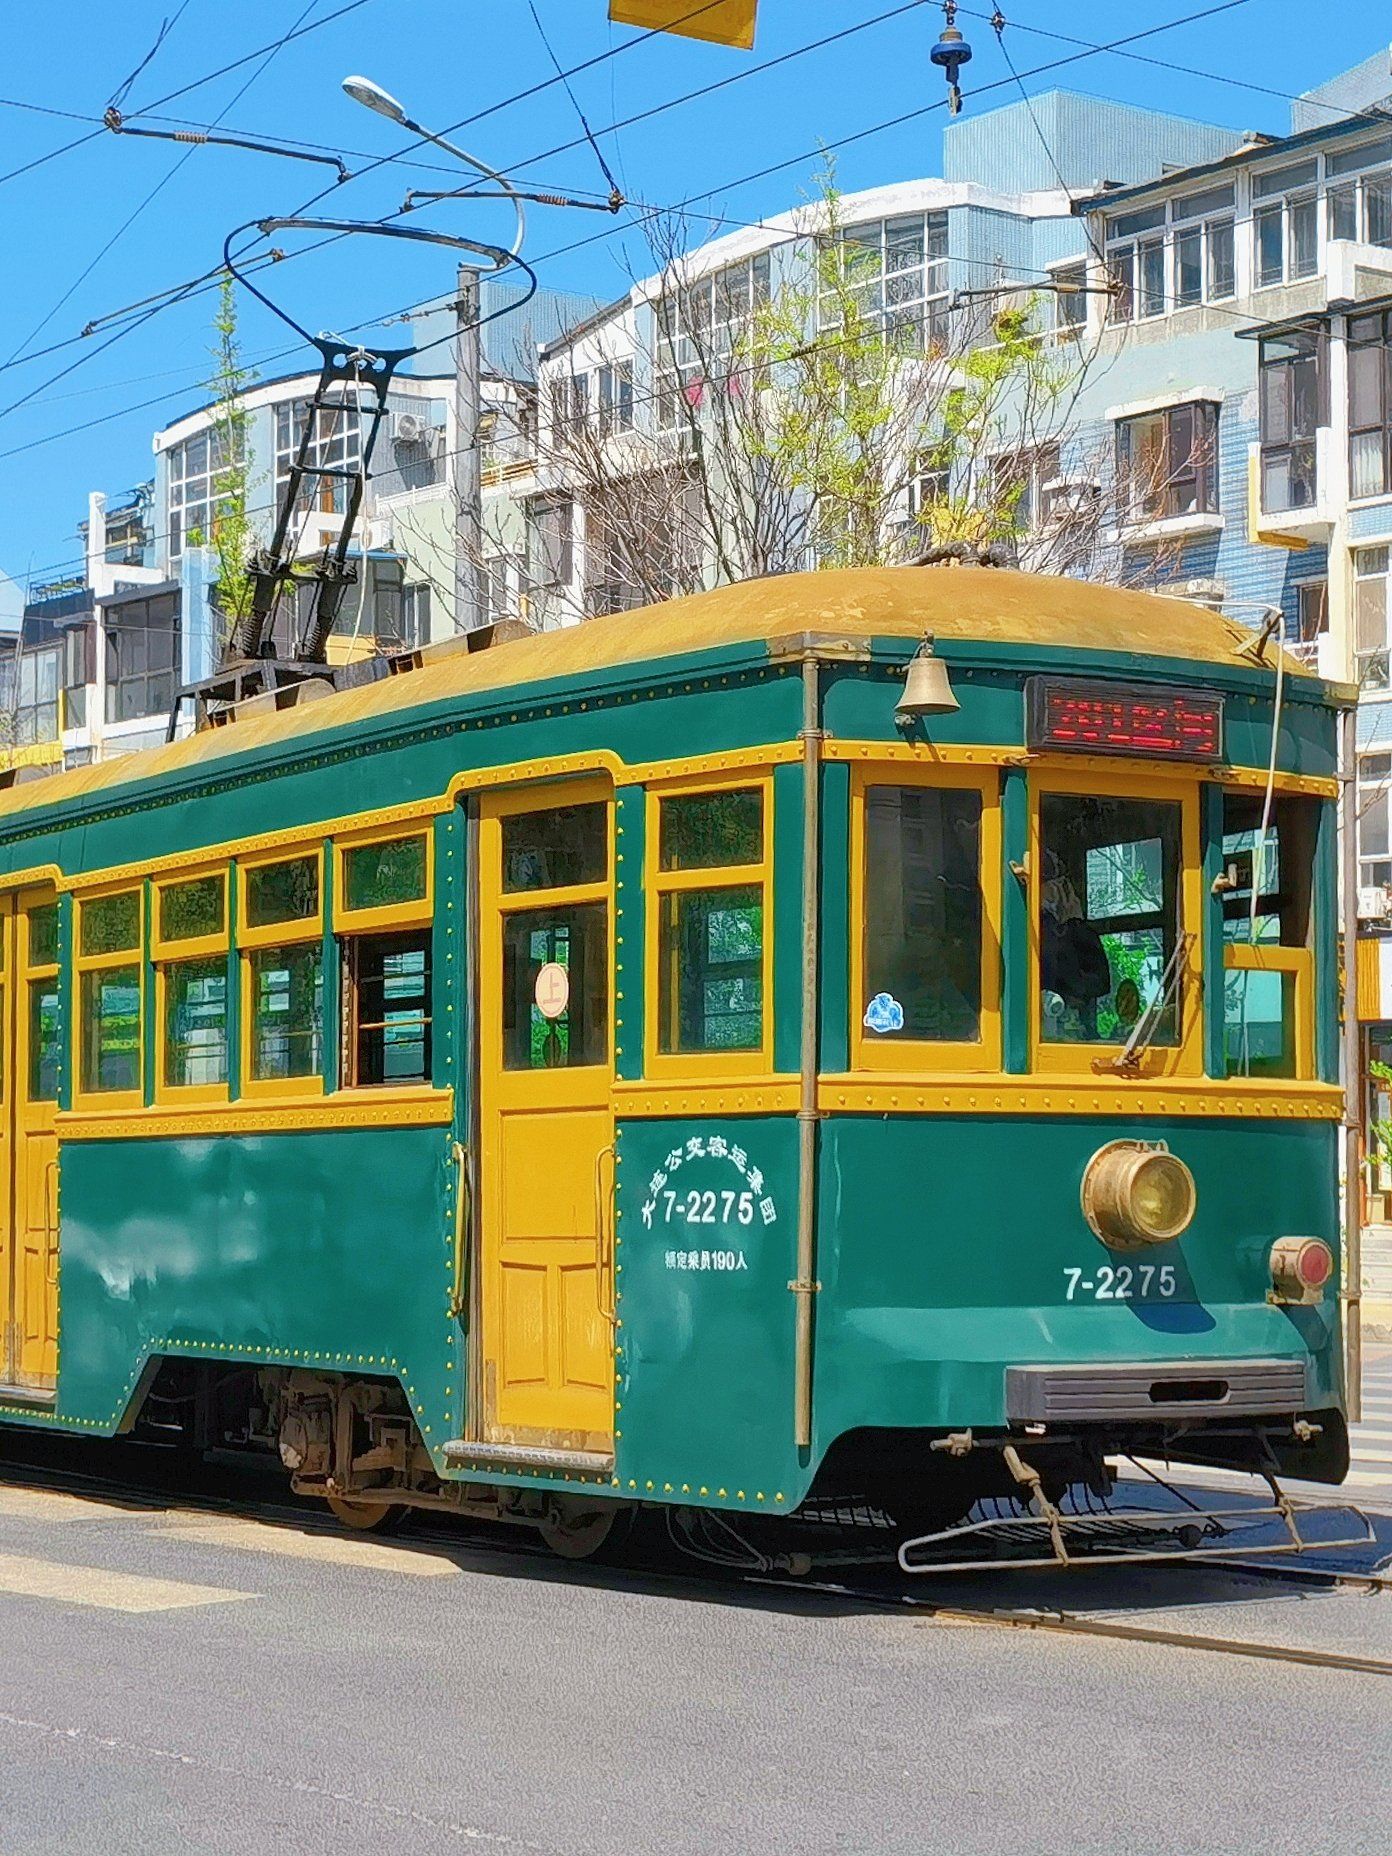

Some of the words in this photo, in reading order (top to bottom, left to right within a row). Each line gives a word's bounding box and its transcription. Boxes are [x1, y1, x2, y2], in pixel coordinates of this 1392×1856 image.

[543, 972, 562, 1005] 上
[663, 1190, 754, 1224] 7-2275
[1063, 1265, 1176, 1300] 7-2275
